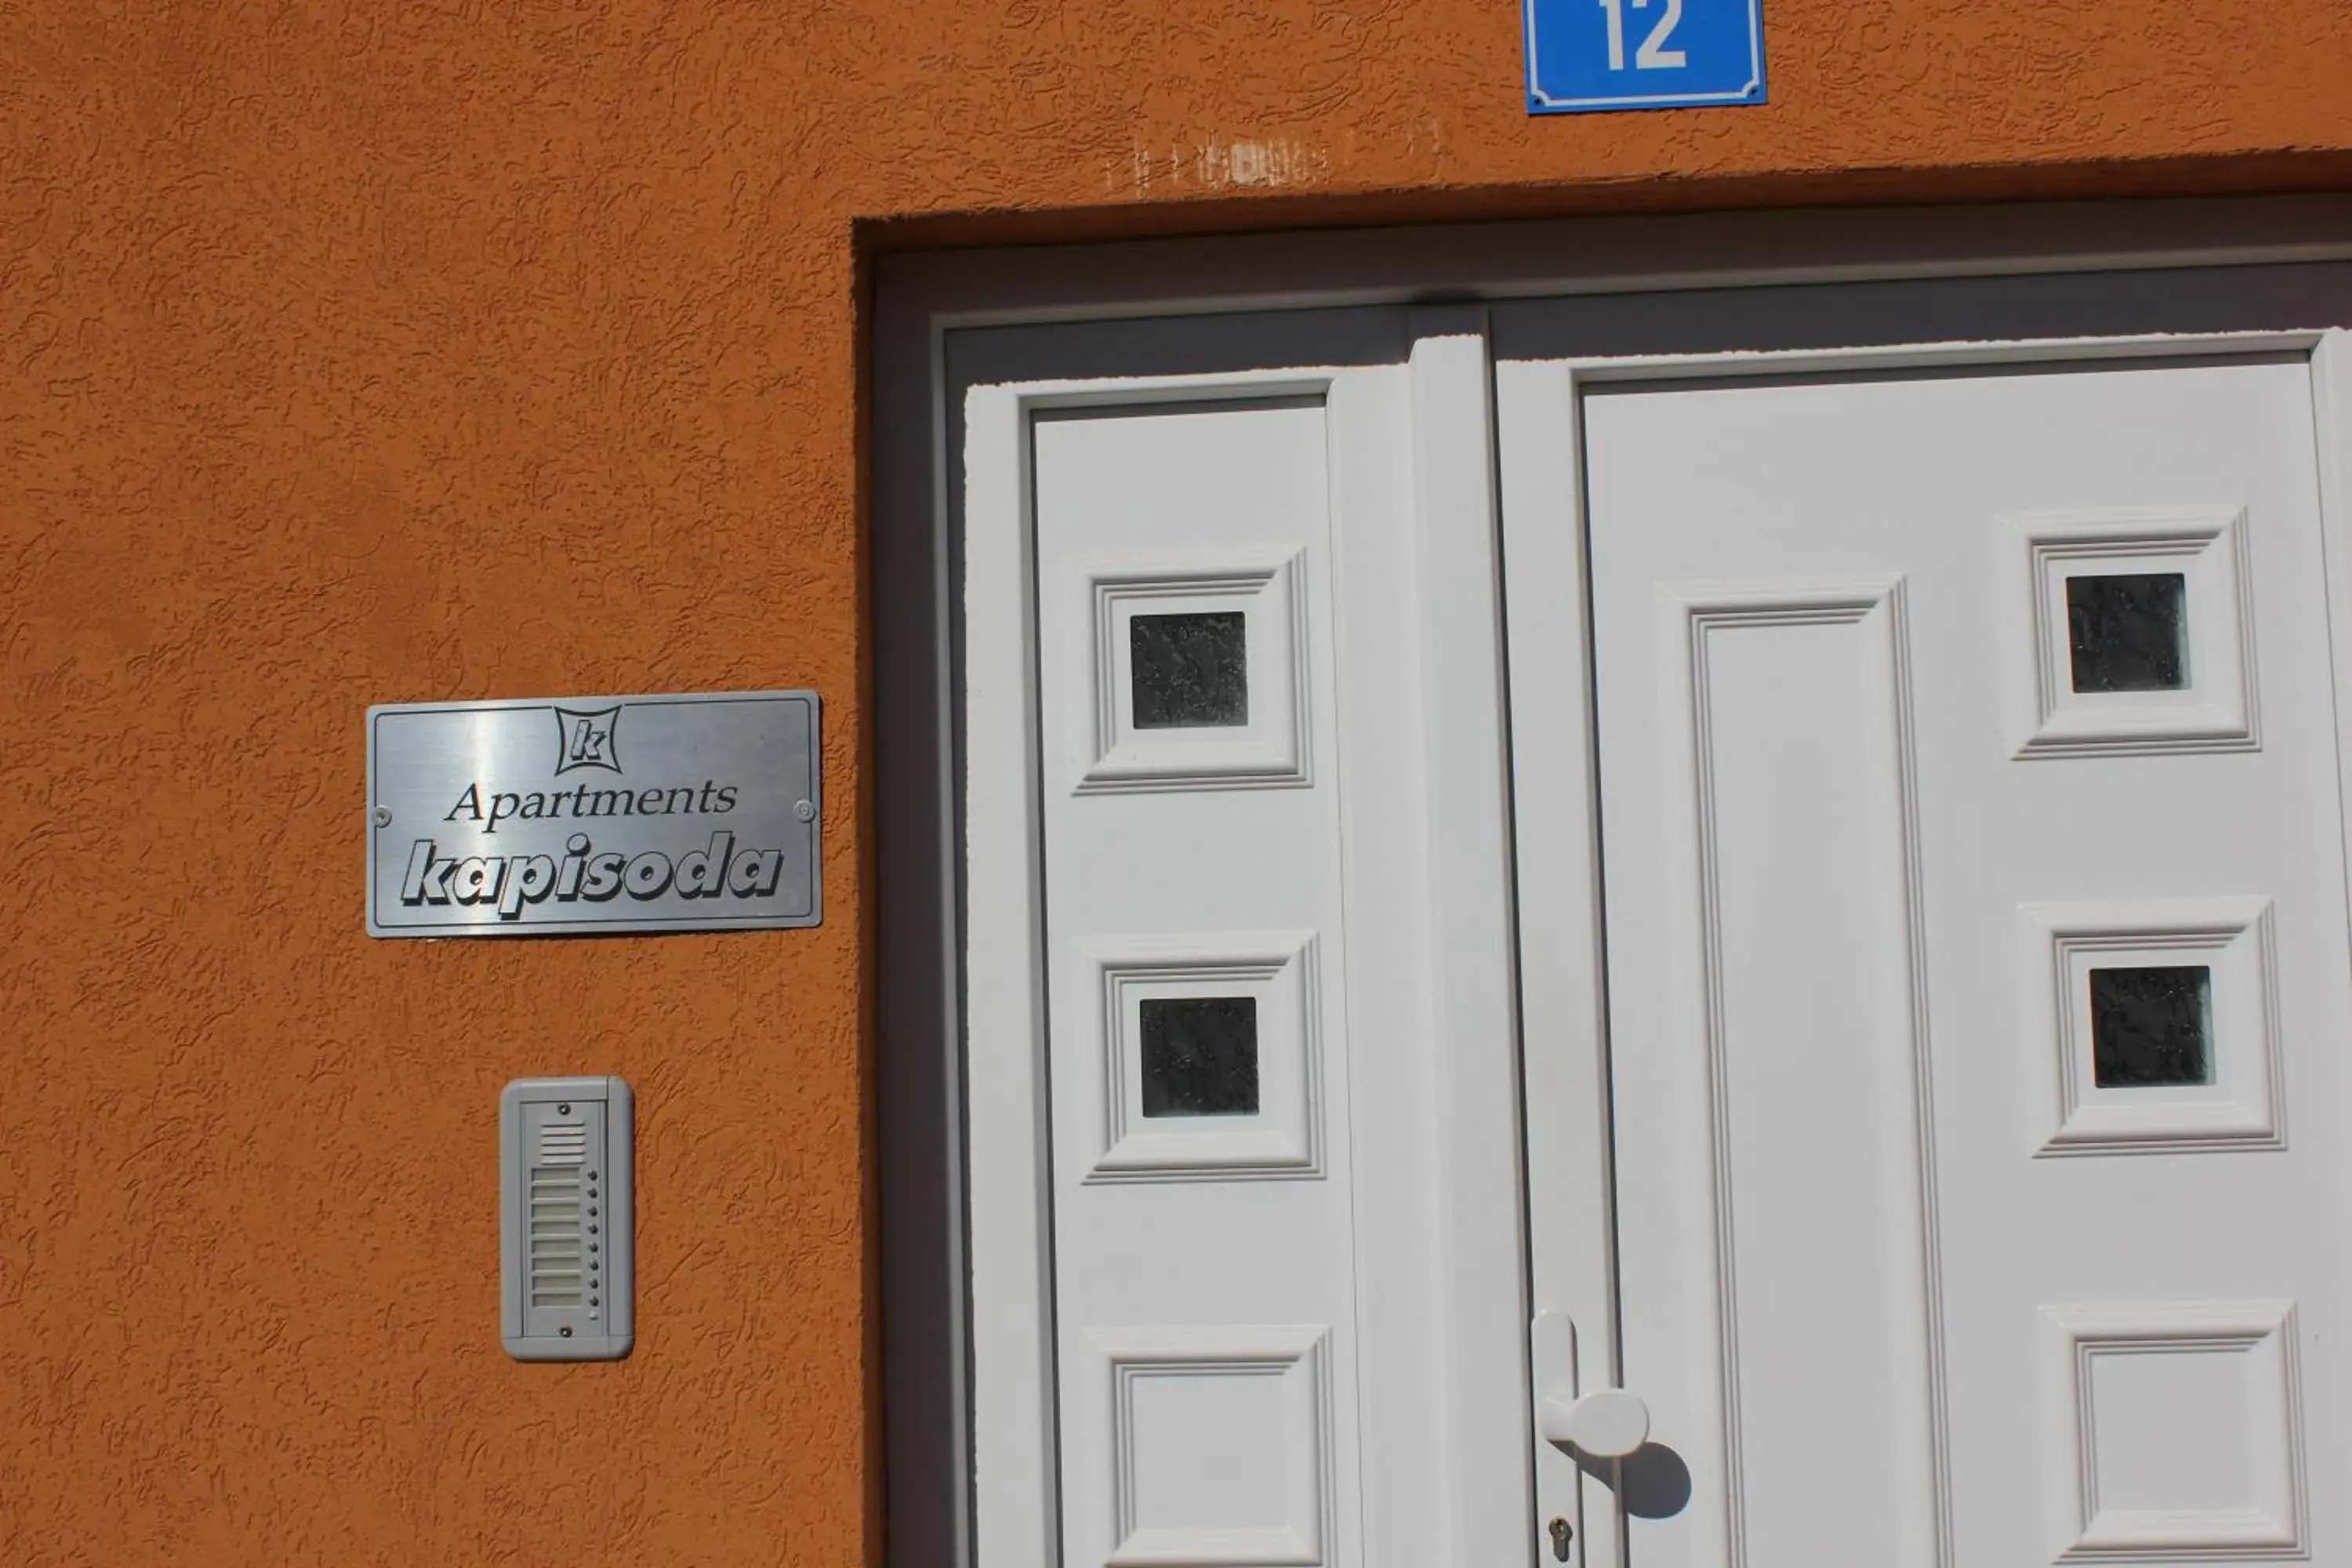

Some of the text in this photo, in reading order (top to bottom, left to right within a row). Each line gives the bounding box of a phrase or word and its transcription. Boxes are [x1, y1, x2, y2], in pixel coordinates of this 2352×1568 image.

[1599, 0, 1686, 71] 12
[443, 779, 739, 833] Apartments
[401, 830, 782, 920] kapisoda
